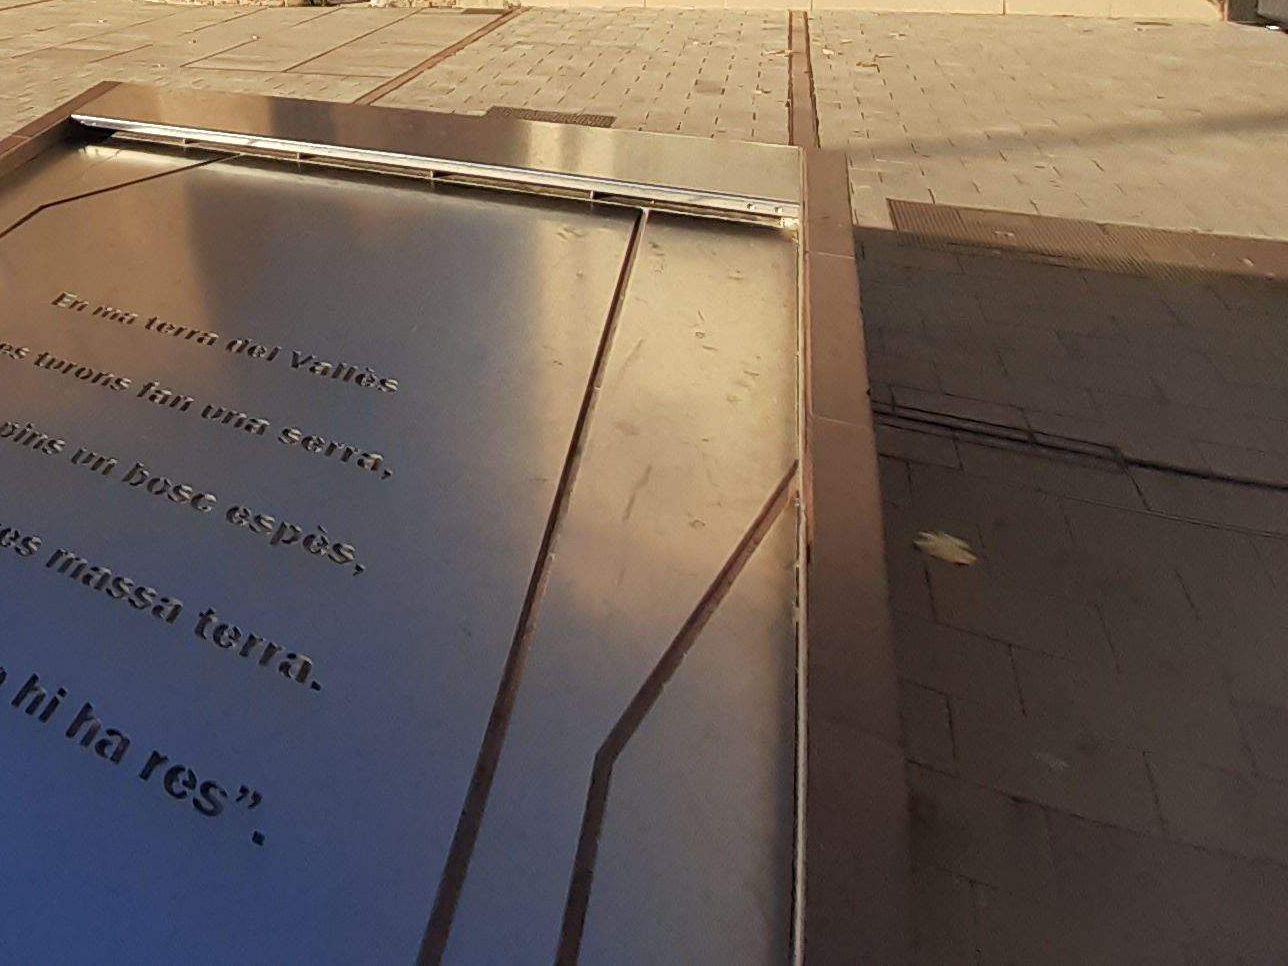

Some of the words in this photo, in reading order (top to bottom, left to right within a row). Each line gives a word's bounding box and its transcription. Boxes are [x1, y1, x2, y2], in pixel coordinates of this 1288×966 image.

[51, 291, 89, 312] En
[92, 306, 139, 325] ma
[144, 315, 219, 347] terra
[225, 337, 282, 362] del
[290, 348, 400, 393] Vallès
[33, 351, 133, 393] turons
[136, 379, 194, 412] fan
[200, 403, 271, 436] una
[277, 426, 394, 481] serra,
[70, 446, 119, 476] un
[122, 460, 218, 513] bosc
[225, 505, 367, 577] espès,
[45, 547, 184, 625] massa
[194, 607, 322, 692] terra.
[11, 672, 68, 724] hi
[65, 701, 132, 765] ha
